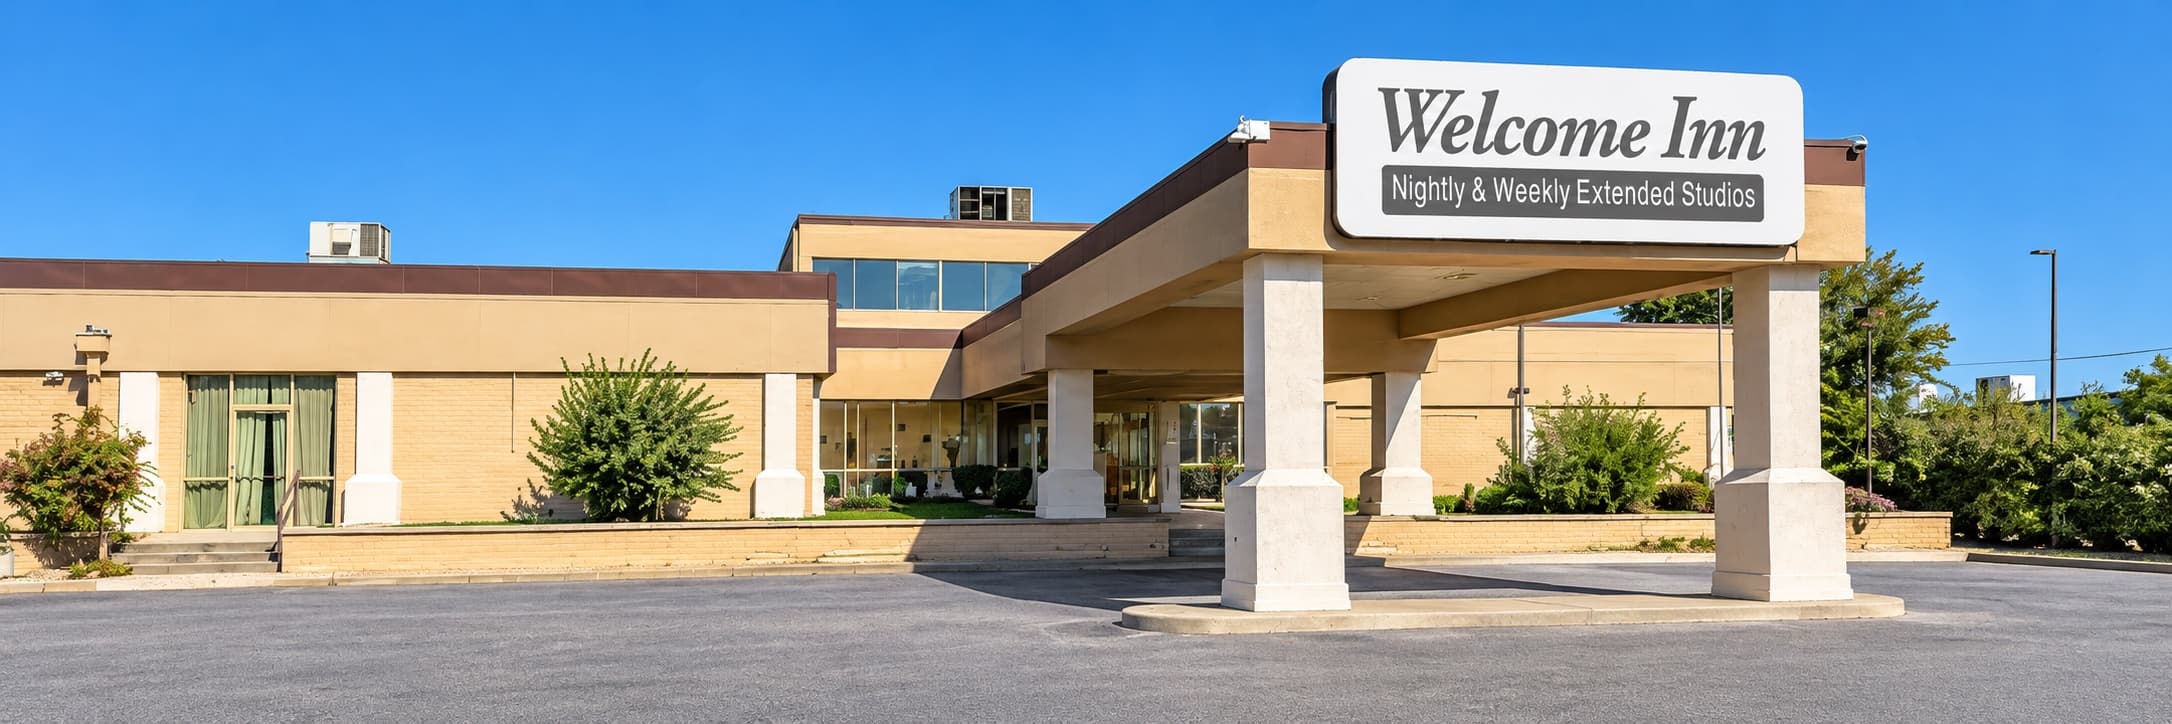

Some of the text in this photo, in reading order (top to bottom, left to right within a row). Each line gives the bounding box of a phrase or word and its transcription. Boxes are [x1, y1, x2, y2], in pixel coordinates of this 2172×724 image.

[1377, 87, 1767, 161] Welcome Inn
[1392, 174, 1756, 210] Nightly & Weekly Extended Studios
